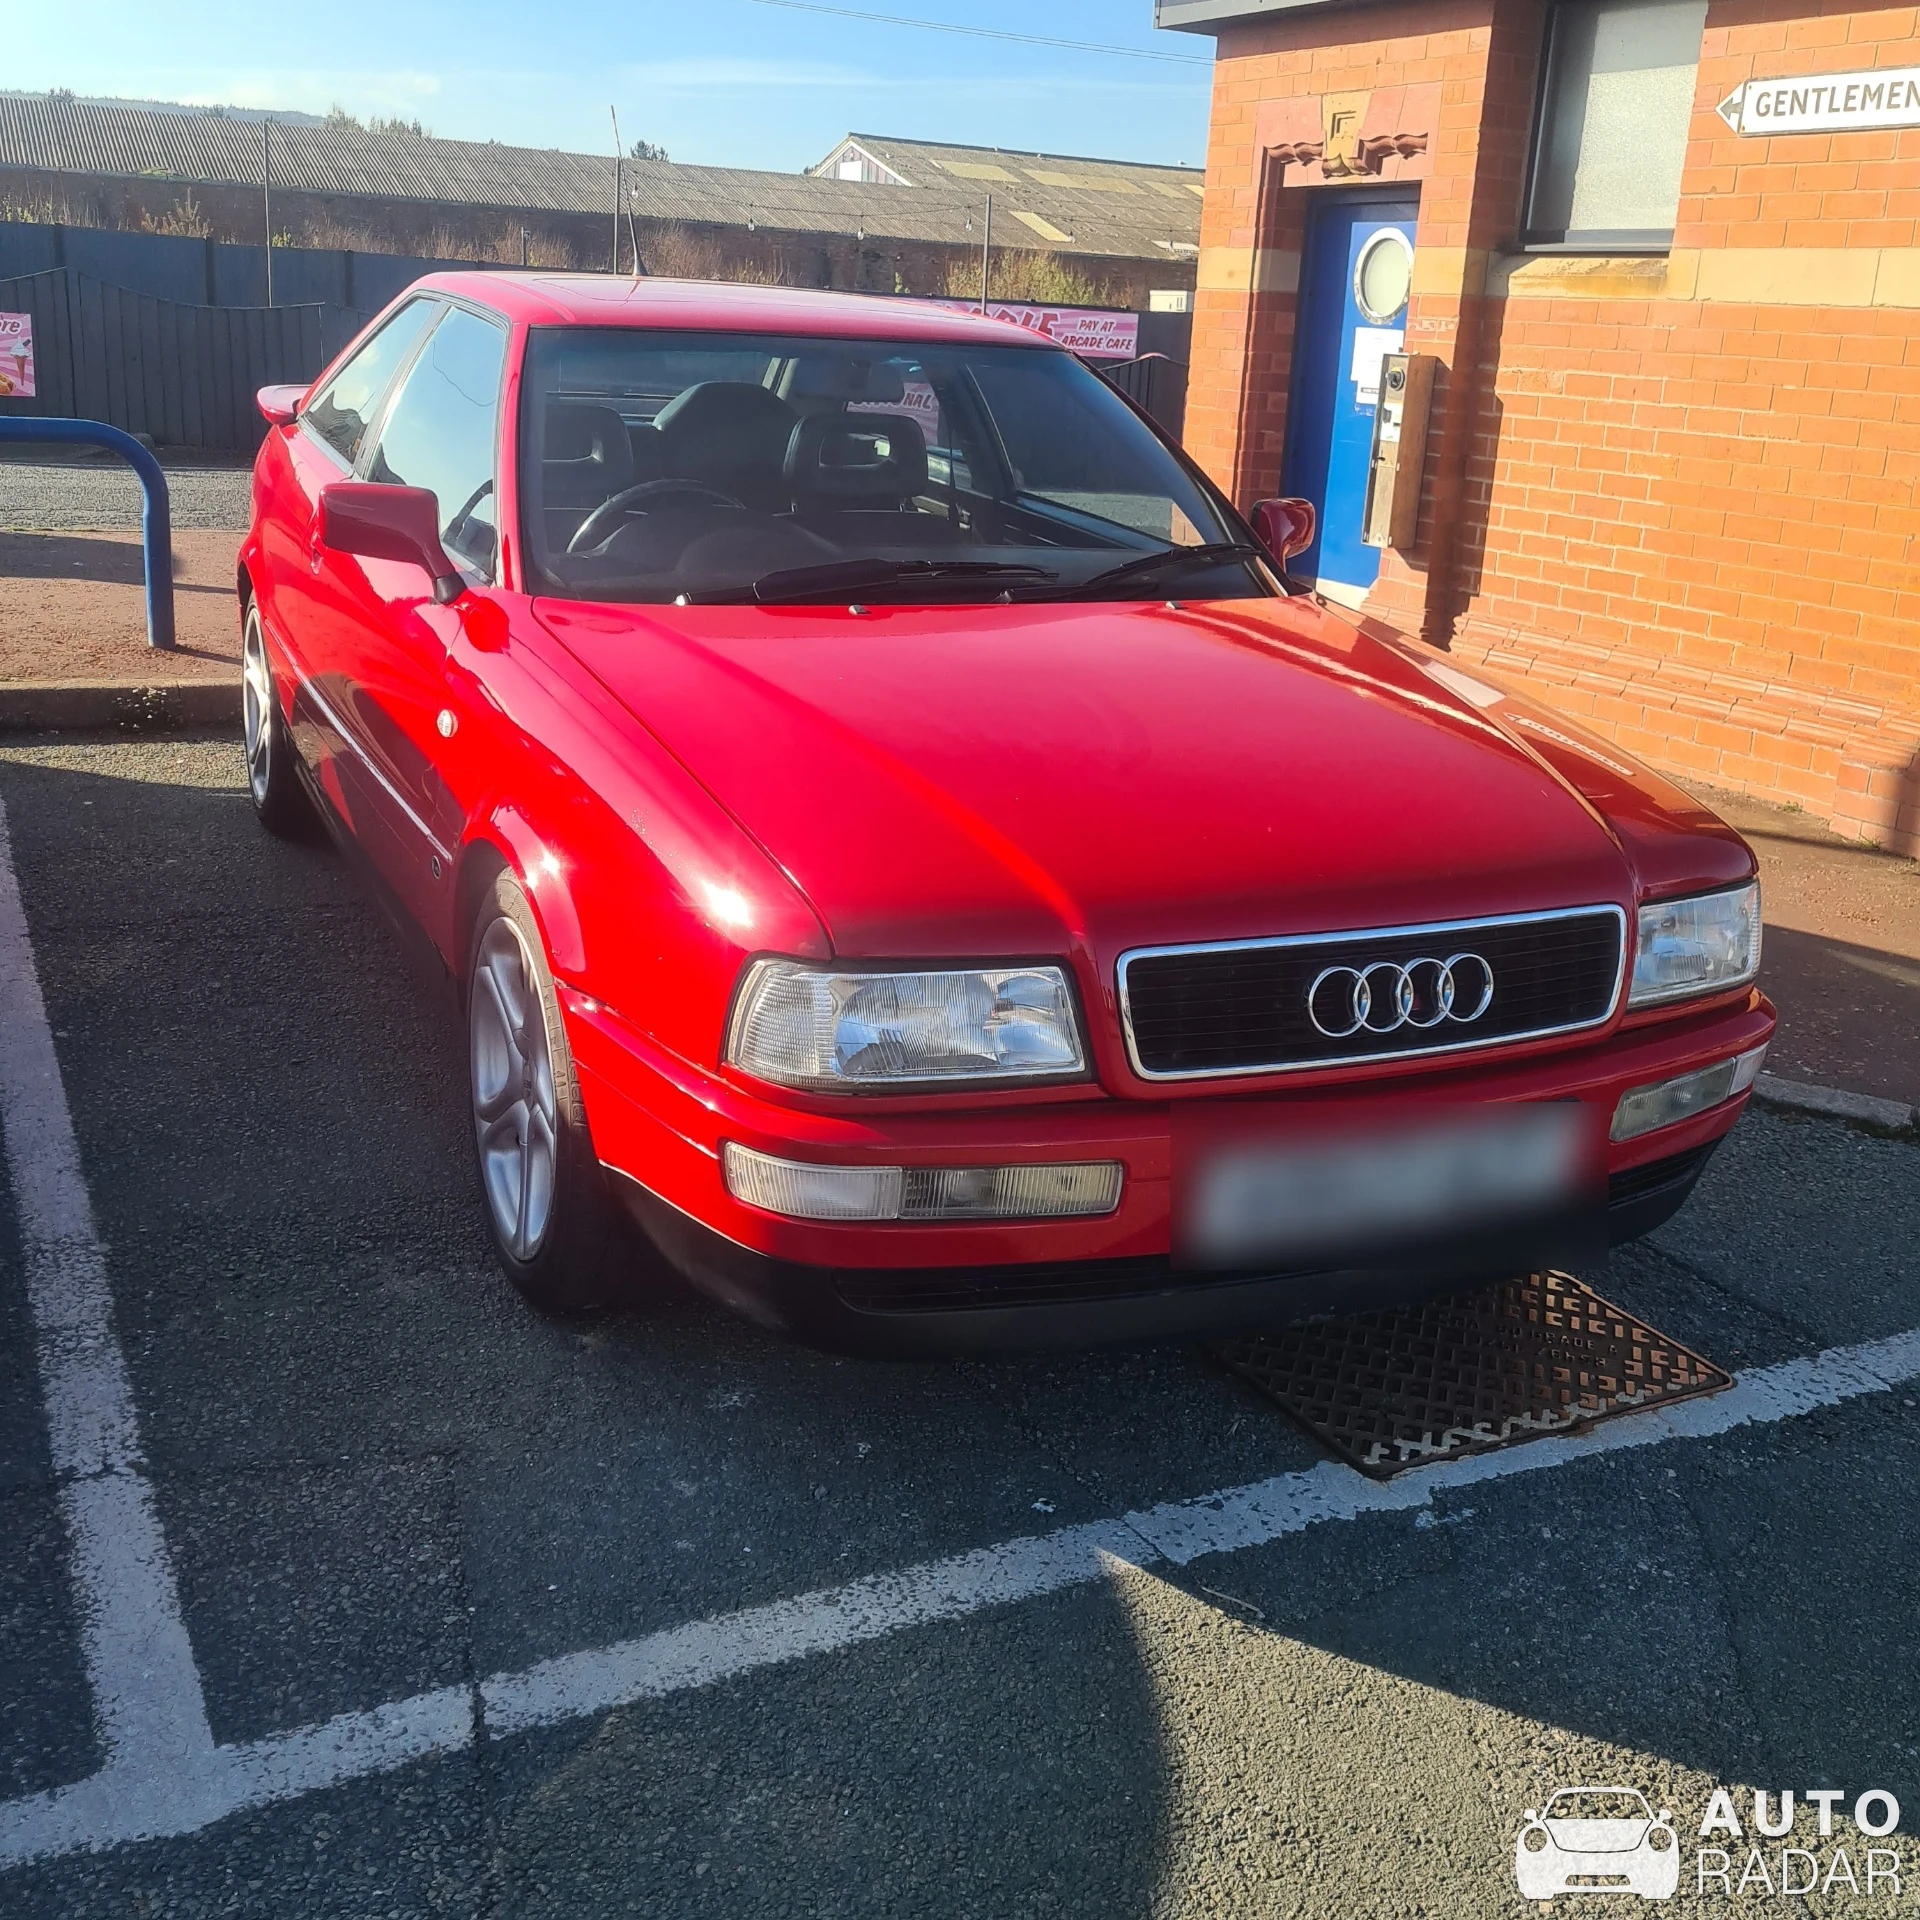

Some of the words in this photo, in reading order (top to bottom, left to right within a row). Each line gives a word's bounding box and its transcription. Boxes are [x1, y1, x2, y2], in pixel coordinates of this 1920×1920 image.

[1755, 80, 1920, 117] GENTLEMEN
[0, 319, 20, 333] re
[1079, 319, 1099, 332] PAY
[1100, 321, 1114, 333] AT
[1062, 335, 1103, 349] ARCADE
[1106, 338, 1133, 351] CAFE
